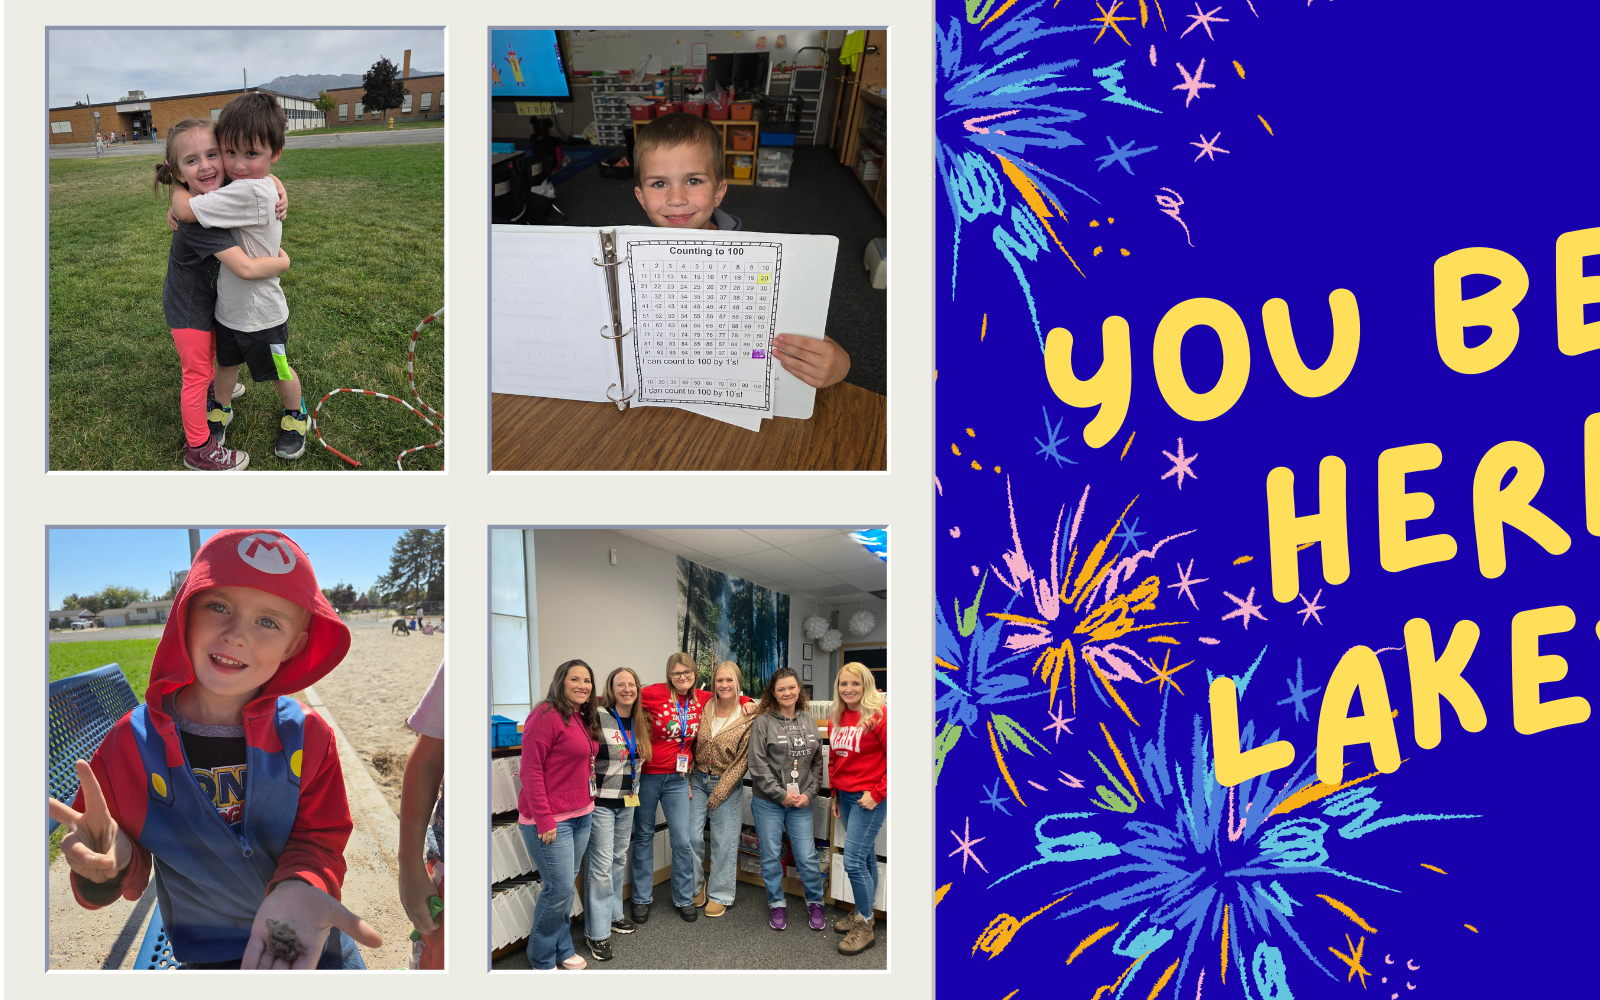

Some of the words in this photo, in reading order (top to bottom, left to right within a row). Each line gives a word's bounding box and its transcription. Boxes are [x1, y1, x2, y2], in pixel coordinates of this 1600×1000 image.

[669, 247, 712, 256] Counting
[245, 537, 290, 565] M
[669, 723, 698, 738] ELF
